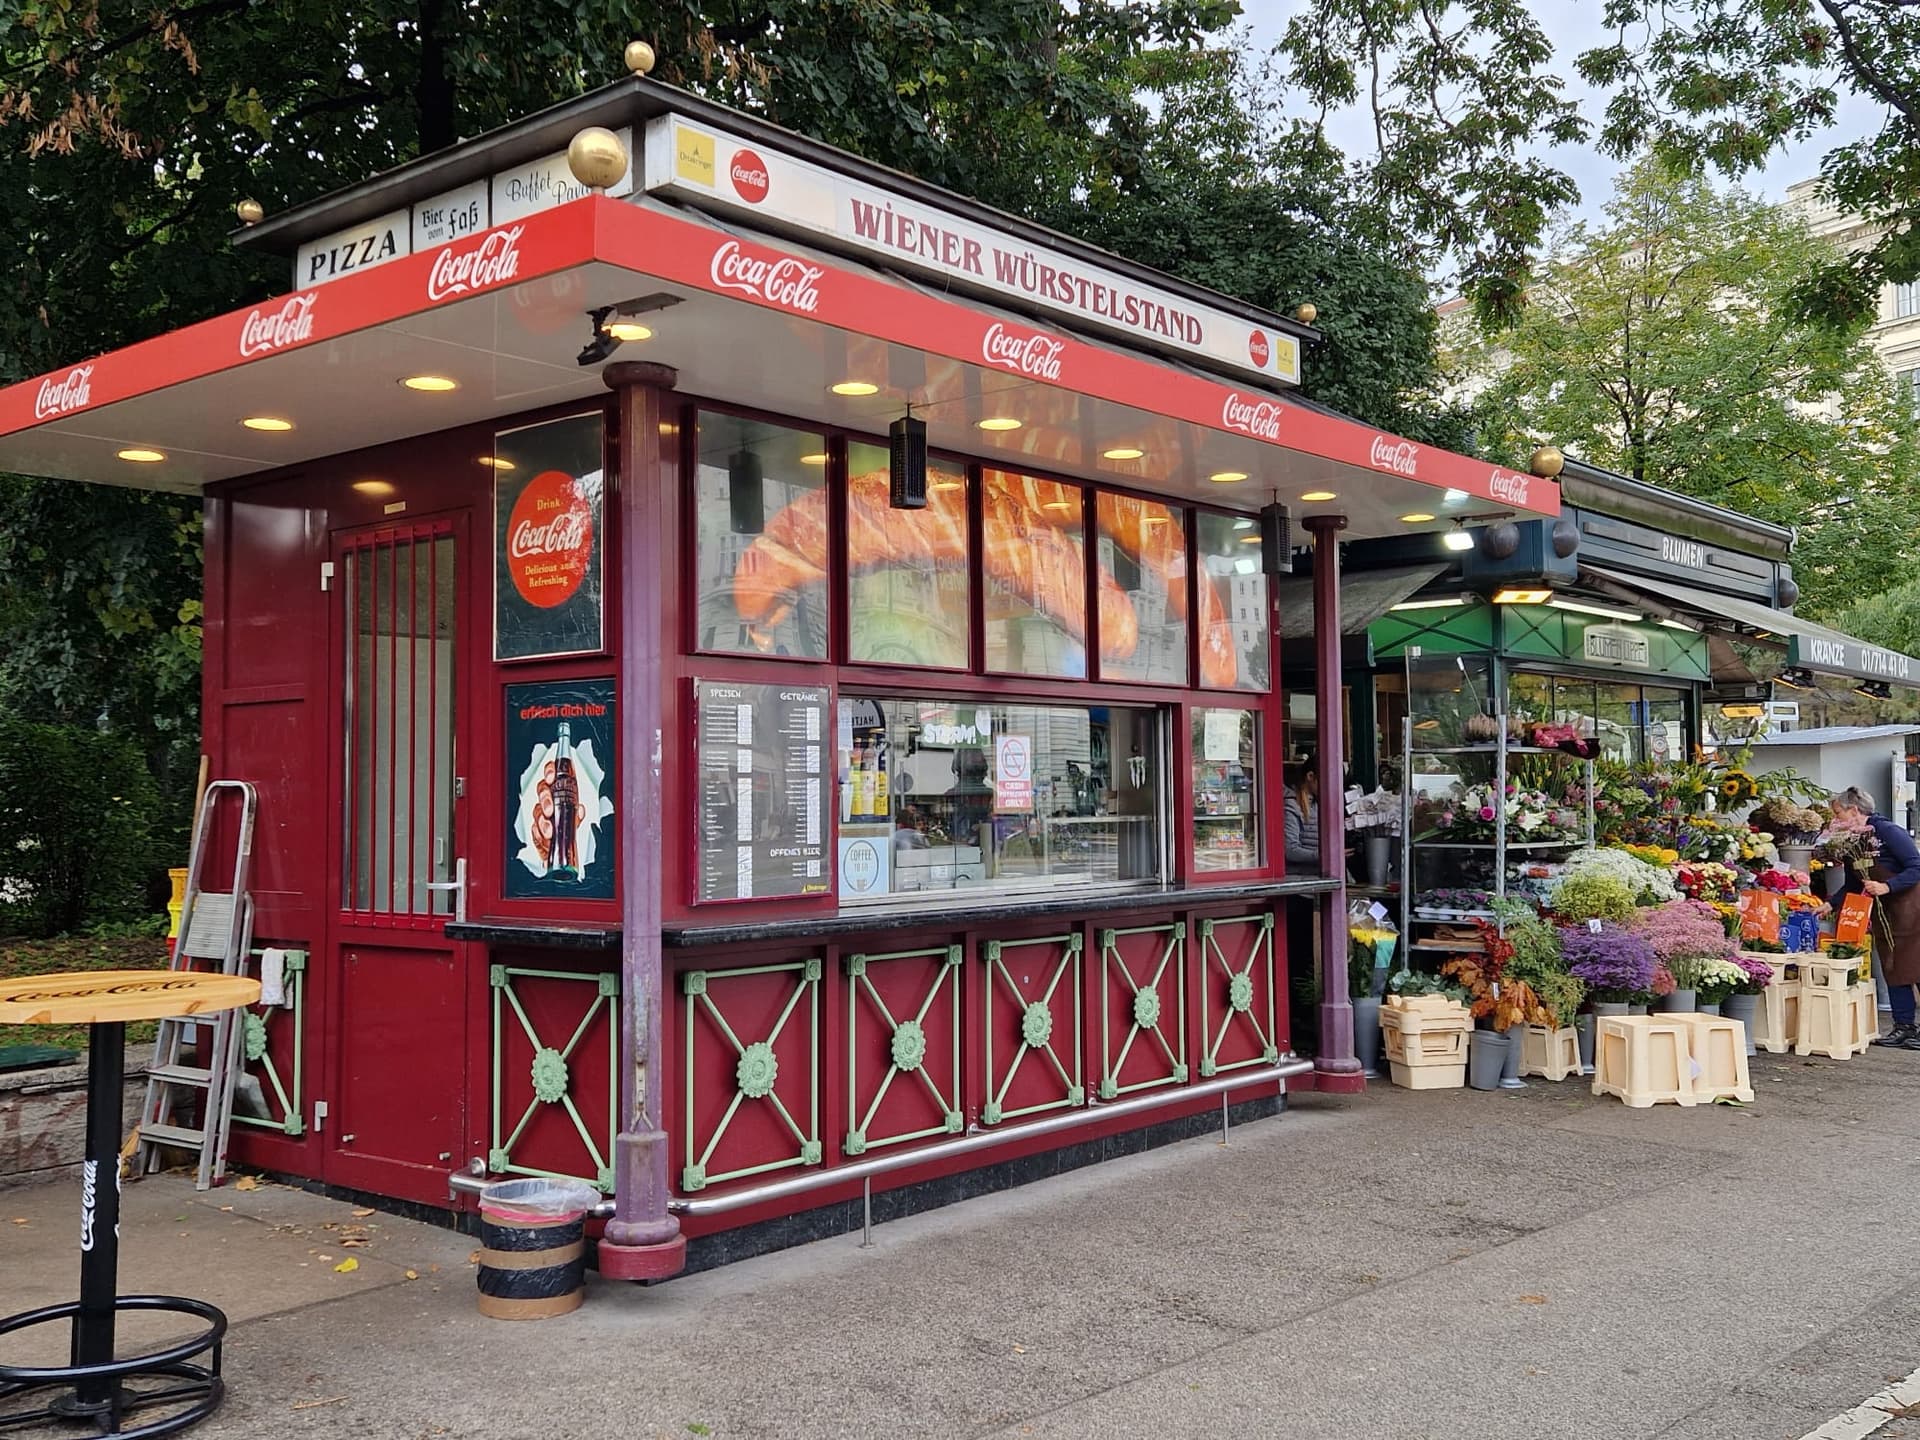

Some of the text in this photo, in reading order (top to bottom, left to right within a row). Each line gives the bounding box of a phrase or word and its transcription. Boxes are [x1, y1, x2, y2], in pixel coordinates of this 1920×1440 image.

[505, 170, 551, 203] Buffet
[732, 164, 767, 188] Coca-Cola
[422, 208, 443, 228] Bier
[308, 229, 397, 282] PIZZA
[427, 225, 525, 301] Coca-Cola
[710, 240, 824, 313] Coca-Cola
[992, 247, 1203, 346] WÜRSTELSTAND
[240, 291, 319, 357] Coca-Cola
[982, 322, 1064, 382] Coca-Cola
[34, 364, 94, 419] Coca-Cola
[1222, 392, 1283, 440] Coca-Cola
[1370, 434, 1419, 475] Coca-Cola
[1489, 468, 1530, 506] Coca-Cola
[536, 498, 561, 512] Drink
[512, 512, 587, 558] Coca-Cola
[1661, 536, 1704, 569] BLUMEN
[525, 563, 558, 576] Delicious
[529, 575, 569, 588] Refreshing
[1899, 655, 1909, 679] 04
[709, 688, 742, 699] SPEISEN
[780, 691, 819, 703] GETRÄNKE
[520, 702, 607, 720] erfrisch dich hier
[850, 848, 873, 861] COFFEE
[5, 979, 201, 1004] Coca-Cola
